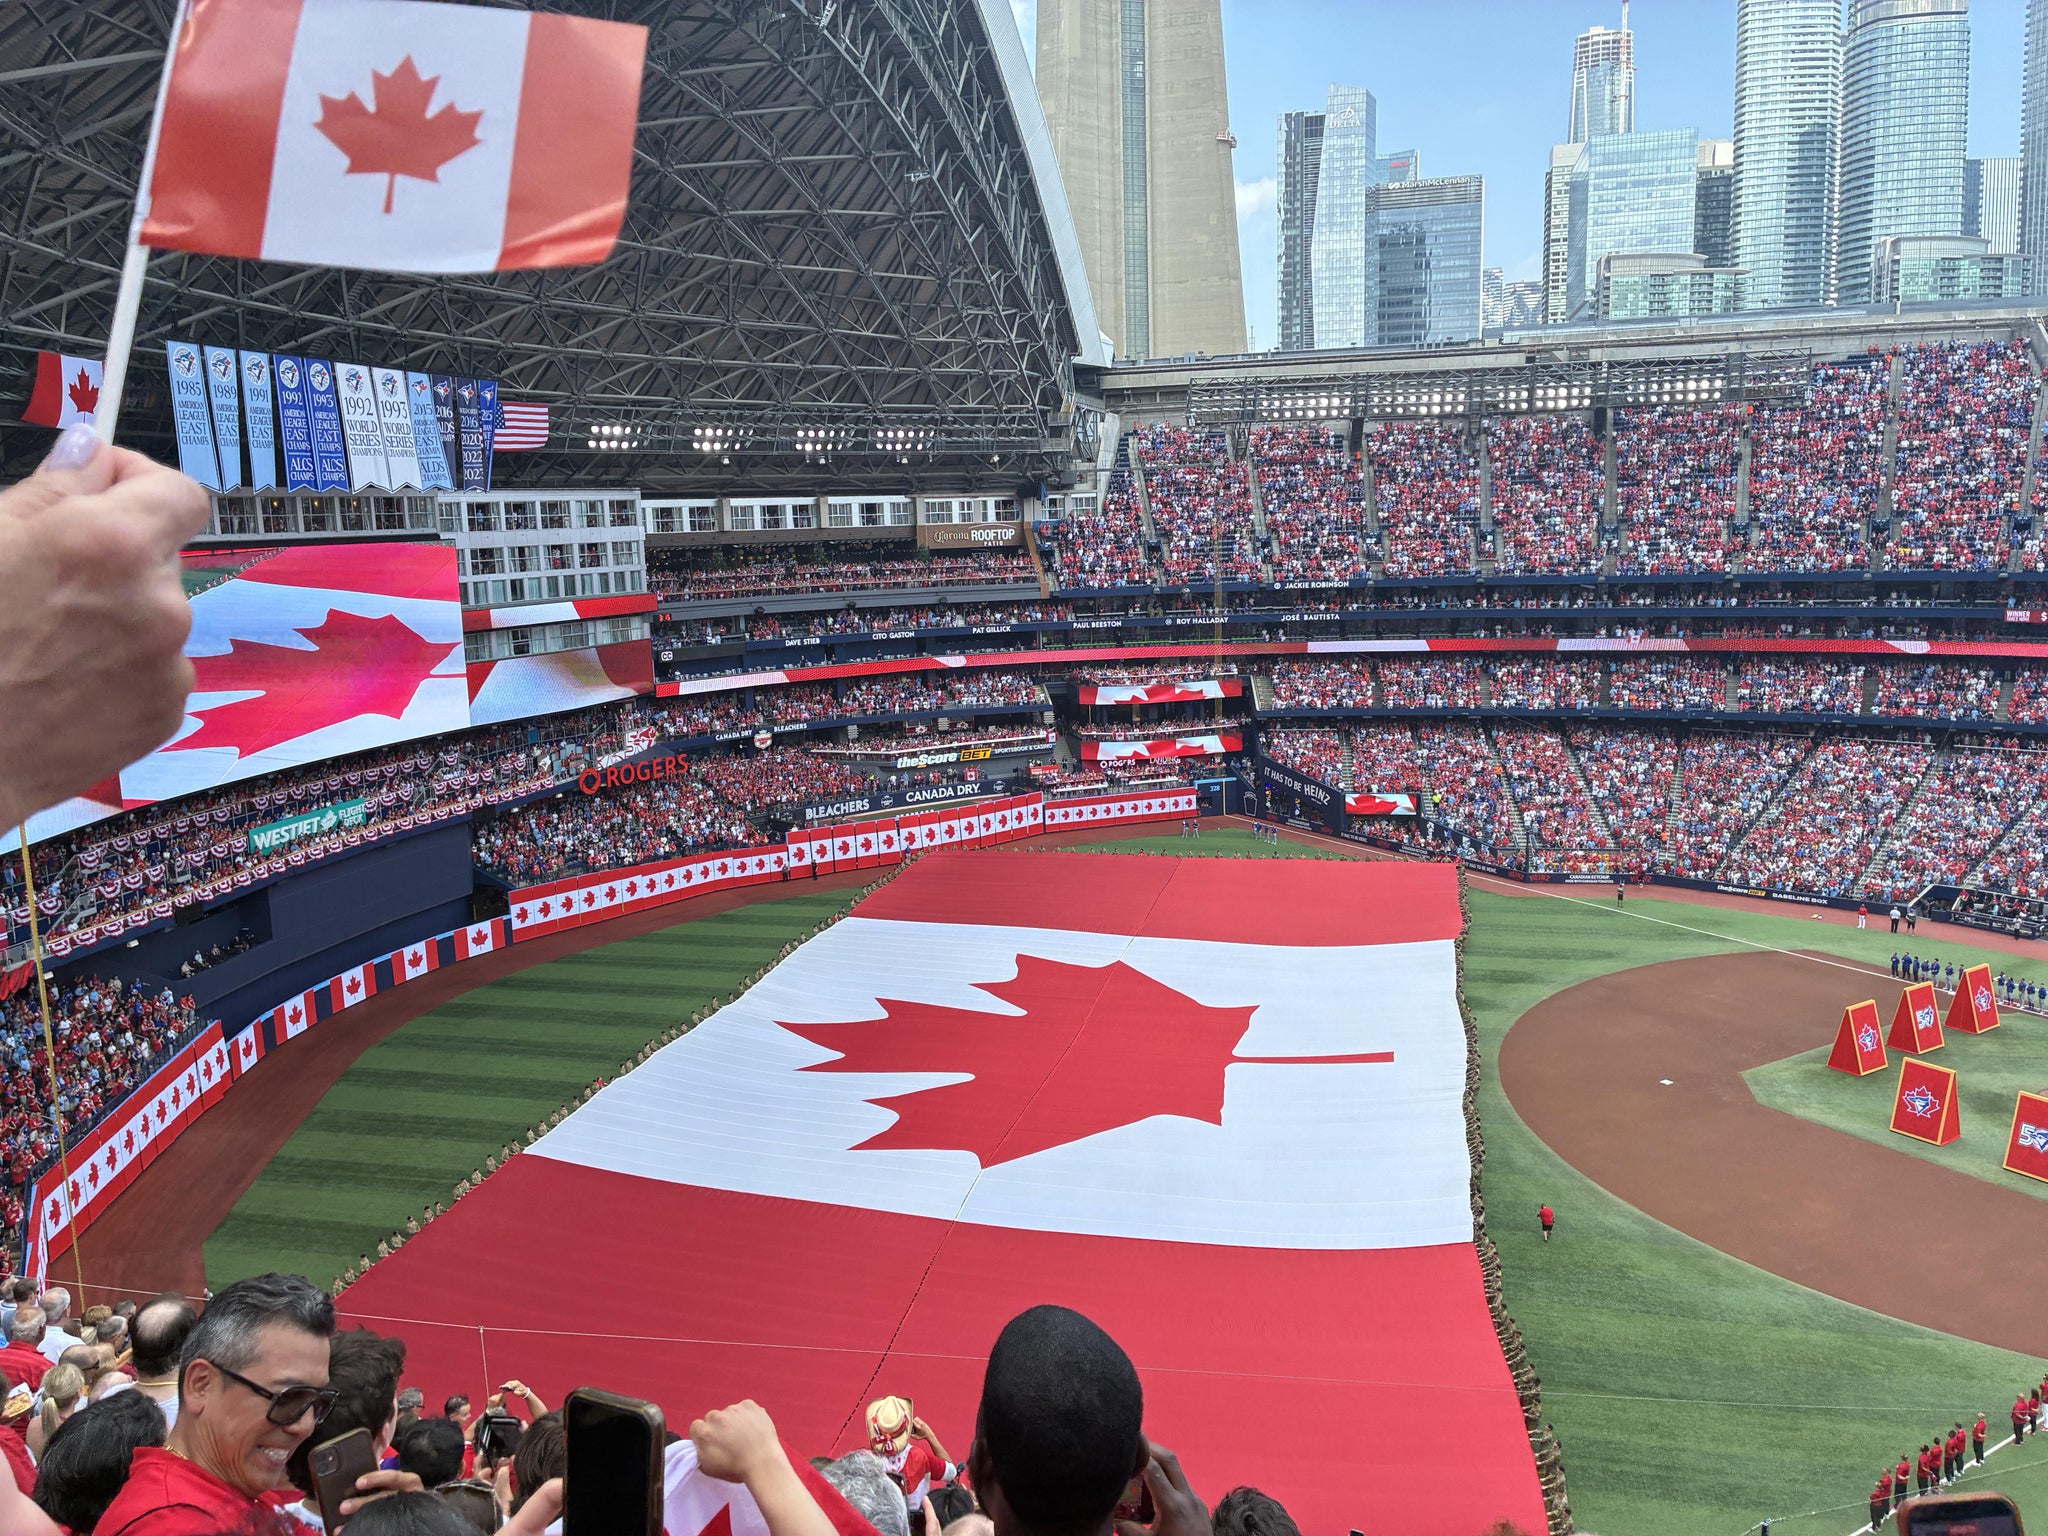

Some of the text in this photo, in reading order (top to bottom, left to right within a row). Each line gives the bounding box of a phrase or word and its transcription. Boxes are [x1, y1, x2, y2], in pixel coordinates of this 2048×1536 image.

[1328, 120, 1360, 128] DELTA
[1401, 176, 1470, 188] MarshMcLennan
[176, 381, 201, 396] 1985
[214, 384, 237, 399] 1989
[250, 388, 269, 402] 1991
[282, 391, 303, 405] 1992
[313, 394, 334, 407] 1993
[344, 396, 373, 416] 1992
[381, 400, 407, 419] 1993
[414, 403, 432, 415] 2015
[436, 406, 453, 418] 2016
[179, 410, 206, 421] LEAGUE
[461, 416, 478, 428] 2016
[180, 421, 207, 435] EAST
[252, 426, 273, 439] EAST
[346, 420, 378, 433] WORLD
[383, 422, 411, 436] WORLD
[182, 436, 210, 445] CHAMPS
[286, 429, 308, 441] EAST
[317, 430, 339, 442] EAST
[349, 434, 380, 447] SERIES
[415, 436, 438, 446] EAST
[461, 434, 481, 445] 2020
[252, 440, 273, 448] CHAMP
[287, 441, 310, 450] CHAMPS
[385, 436, 413, 448] SERIES
[351, 447, 383, 456] CHAMPIONS
[290, 458, 313, 471] ALCS
[322, 458, 344, 472] ALCS
[421, 461, 445, 473] ALDS
[934, 529, 1015, 543] Corona ROOFTOP
[715, 732, 740, 741] CANADA
[774, 723, 807, 732] BLEACHERS
[897, 752, 958, 768] theScore
[962, 750, 990, 760] BET
[606, 754, 689, 787] ROGERS
[1264, 767, 1270, 776] IT
[1271, 769, 1283, 783] HAS
[1284, 776, 1293, 787] TO
[1294, 781, 1302, 792] BE
[1304, 784, 1331, 805] HEINZ
[806, 799, 870, 820] BLEACHERS
[906, 786, 955, 802] CANADA
[254, 804, 365, 849] WESTJET FLIGHT
[1717, 885, 1748, 893] theScore
[1772, 892, 1810, 902] BASELINE
